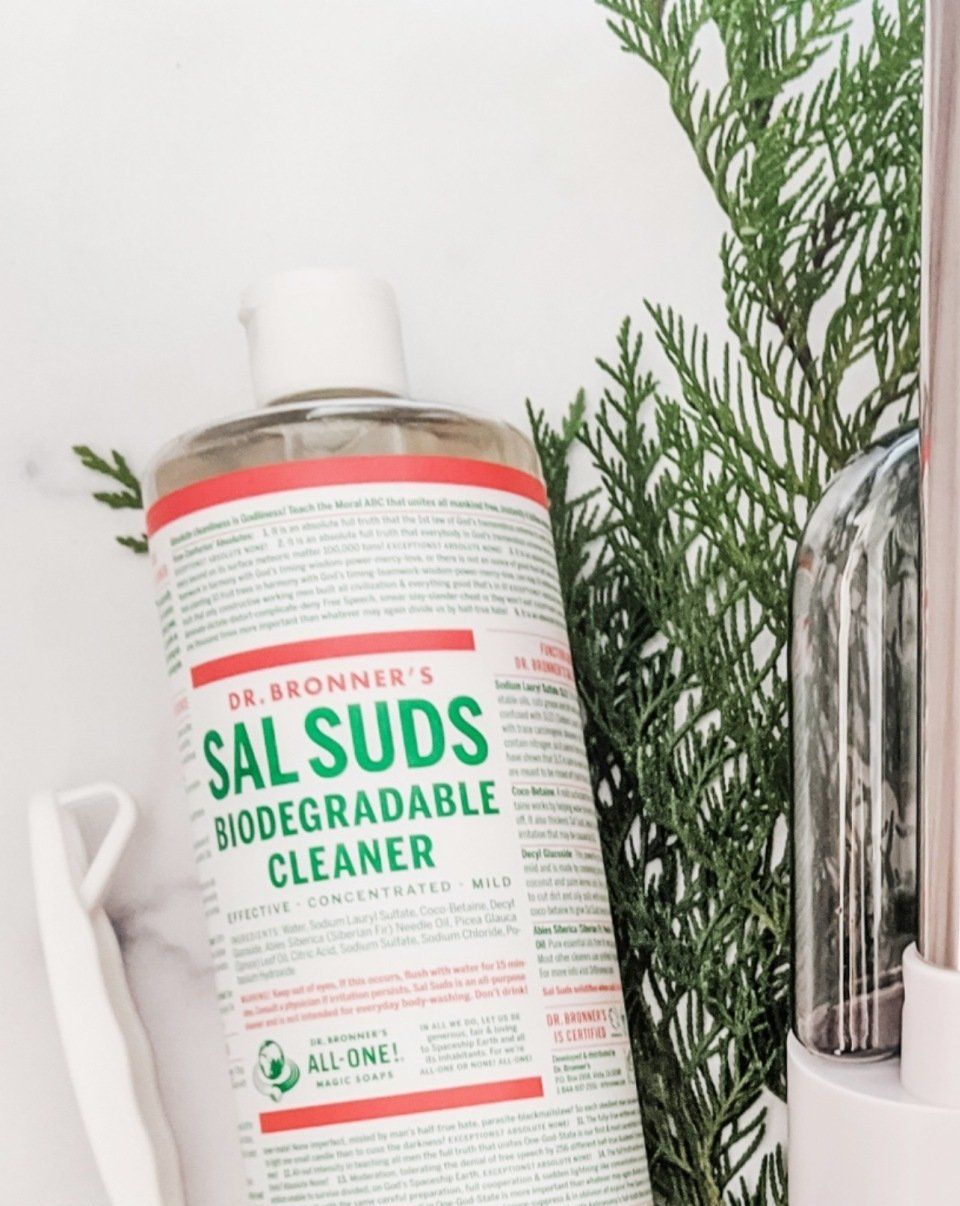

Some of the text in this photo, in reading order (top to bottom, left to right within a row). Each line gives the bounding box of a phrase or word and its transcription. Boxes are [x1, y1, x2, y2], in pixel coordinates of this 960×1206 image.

[289, 503, 314, 514] Teach
[317, 501, 333, 510] the
[335, 499, 362, 510] Moral
[364, 497, 384, 507] ABC
[386, 497, 406, 507] that
[408, 497, 435, 507] unites
[382, 515, 399, 524] that
[401, 515, 416, 524] the
[401, 528, 417, 537] that
[227, 665, 435, 711] DR. BRONNER'S
[203, 715, 299, 800] SAL
[304, 695, 490, 779] SUDS
[215, 780, 500, 852] BIODEGRADABLE
[268, 833, 435, 889] CLEANER
[227, 876, 512, 924] EFFECTIVE CONCENTRATED MILD
[308, 917, 345, 929] Sodium
[347, 910, 379, 924] Lauryl
[490, 899, 515, 911] Decyl
[396, 920, 432, 933] Needle
[485, 913, 517, 924] Glauca
[340, 939, 379, 954] Sodium
[421, 931, 460, 943] Sodium
[405, 967, 428, 979] flush
[430, 965, 451, 976] with
[453, 963, 479, 974] water
[481, 961, 494, 971] for
[496, 960, 506, 970] 15
[413, 981, 428, 992] Sal
[430, 980, 453, 991] Suds
[464, 978, 477, 986] an
[340, 1005, 353, 1016] for
[356, 999, 399, 1014] everyday
[475, 987, 500, 999] Don't
[502, 984, 528, 996] drink!
[431, 1021, 446, 1030] ALL
[449, 1019, 461, 1028] WE
[481, 1015, 495, 1025] LET
[497, 1013, 509, 1022] US
[494, 1024, 517, 1034] loving
[328, 1029, 388, 1044] BRONNER'S
[420, 1032, 525, 1054] to Spaceship Earth and all
[554, 1030, 563, 1044] IS
[308, 1042, 400, 1075] ALL-ONE!
[489, 1046, 501, 1056] For
[316, 1070, 394, 1089] MAGIC SOAPS
[387, 1142, 401, 1152] the
